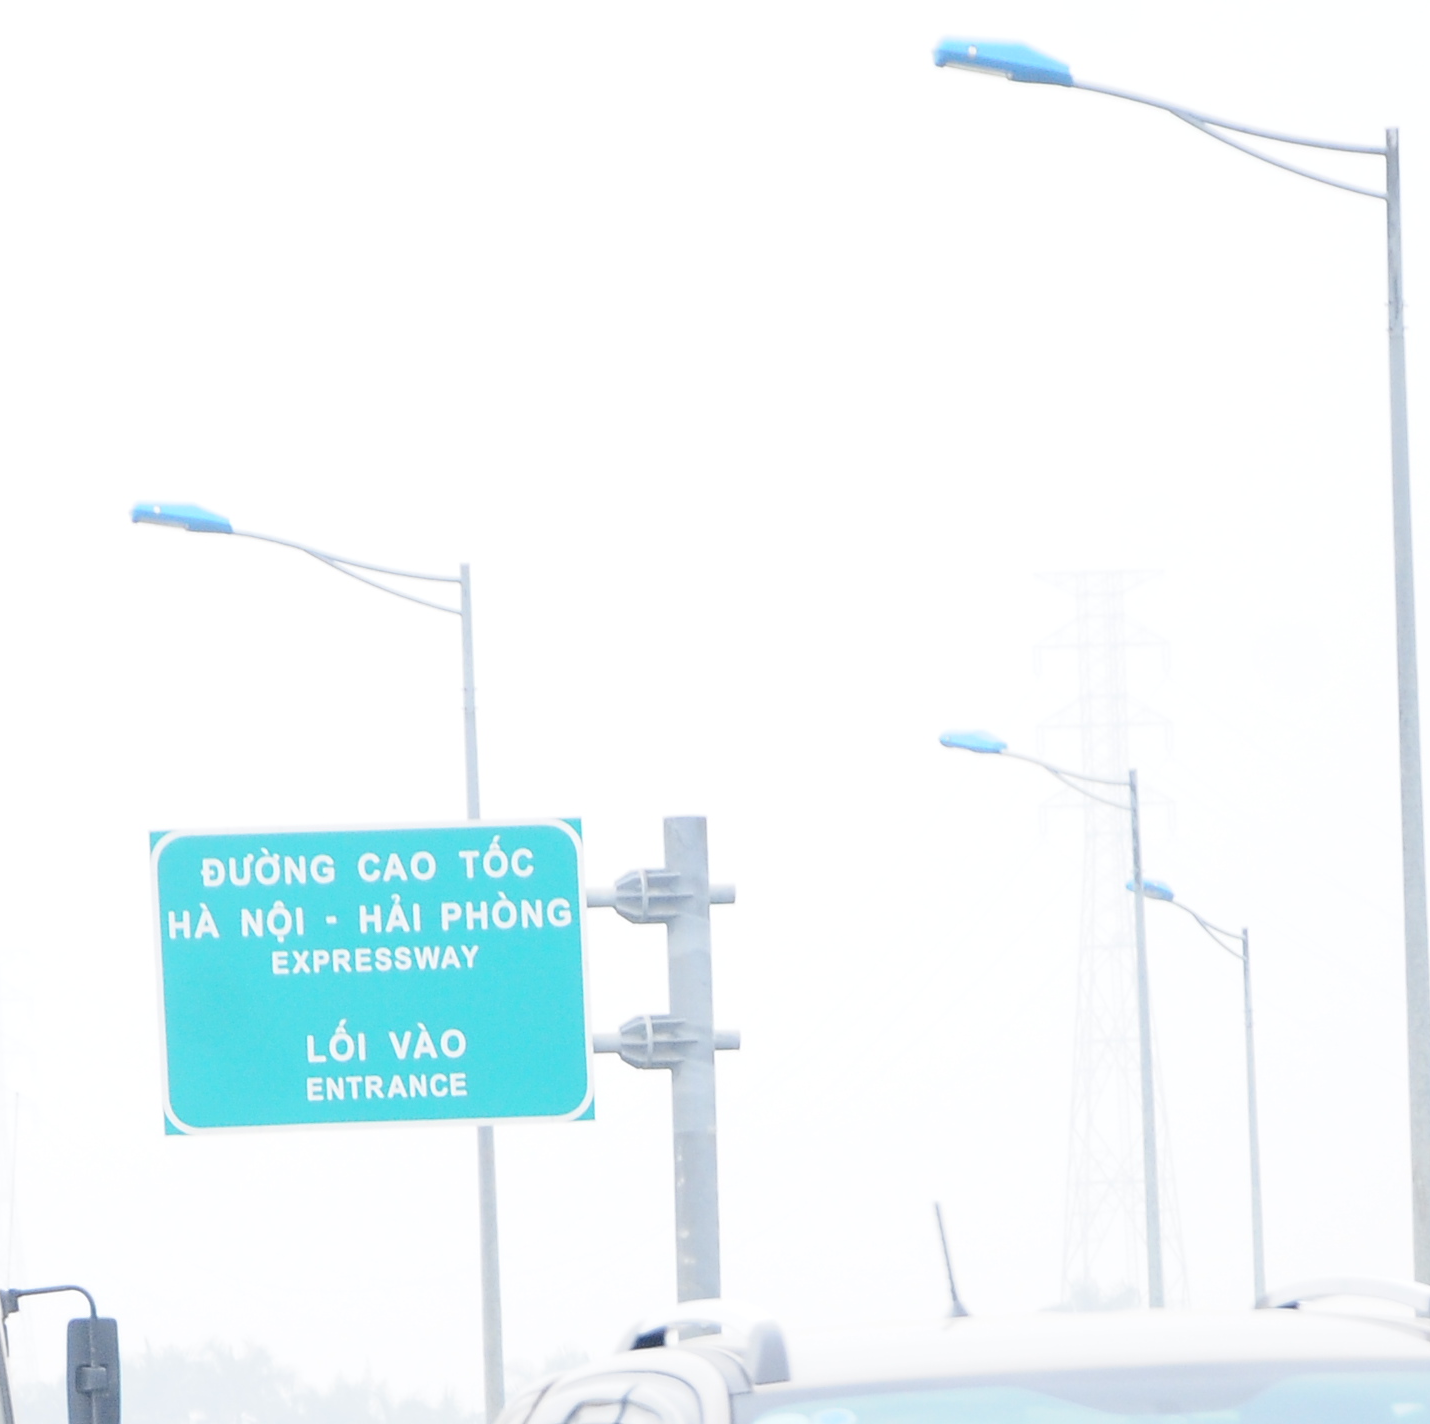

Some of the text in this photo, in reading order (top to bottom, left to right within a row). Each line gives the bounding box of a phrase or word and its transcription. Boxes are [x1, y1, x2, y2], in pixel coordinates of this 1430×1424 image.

[201, 836, 534, 887] ĐƯỜNG CAO TỐC
[168, 892, 572, 942] HÀ NỘI - HẢI PHÒNG
[272, 945, 479, 975] EXPRESSWAY
[306, 1019, 467, 1063] LỐI VÀO
[306, 1073, 468, 1101] ENTRANCE
